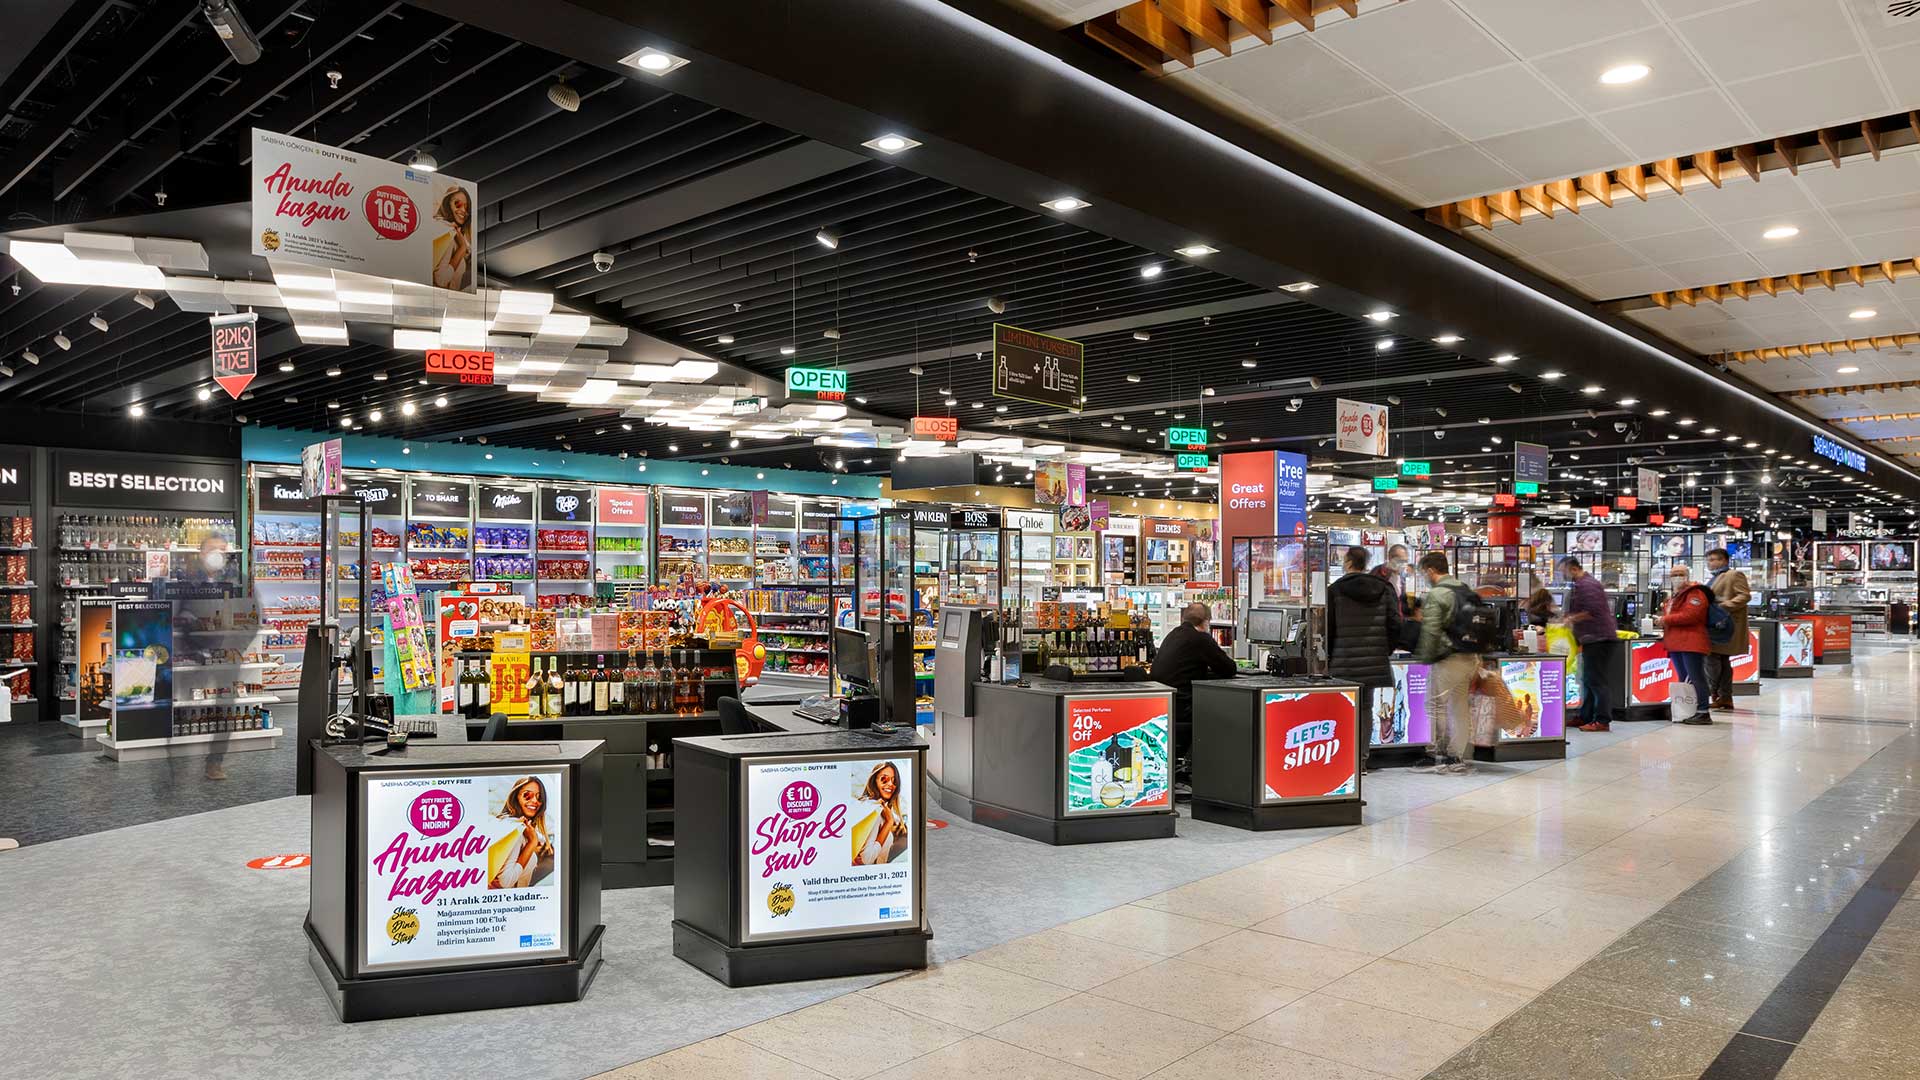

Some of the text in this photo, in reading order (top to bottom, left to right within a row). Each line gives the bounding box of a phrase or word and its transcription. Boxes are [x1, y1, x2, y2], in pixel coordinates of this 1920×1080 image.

[322, 150, 340, 161] DUTY
[340, 154, 358, 164] FREE
[264, 162, 354, 200] Anında
[275, 192, 350, 228] kazan
[374, 198, 410, 223] 10 €
[427, 352, 494, 371] CLOSE
[791, 371, 846, 389] OPEN
[915, 420, 957, 432] CLOSE
[1170, 430, 1206, 444] OPEN
[1179, 455, 1208, 467] OPEN
[1280, 459, 1302, 479] Free
[1403, 464, 1430, 474] OPEN
[69, 472, 224, 494] BEST SELECTION
[1231, 484, 1264, 494] Great
[1280, 479, 1300, 488] Duty Free
[1375, 480, 1398, 489] OPEN
[436, 495, 459, 503] SHARE
[492, 494, 521, 508] Milka
[1230, 498, 1266, 509] Offers
[927, 512, 948, 523] KLEIN
[964, 512, 988, 523] BOSS
[1018, 516, 1044, 528] Chloé
[1576, 510, 1626, 524] Dior
[1640, 668, 1672, 690] yakala
[1073, 716, 1102, 730] 40%
[1073, 730, 1092, 741] Off
[1293, 722, 1330, 745] LET'S
[1283, 739, 1340, 770] shop
[786, 786, 812, 800] € 10
[786, 800, 813, 808] DISCOUNT
[419, 804, 453, 820] 10 €
[752, 804, 847, 855] Shop &
[373, 825, 491, 876] Anında
[762, 846, 818, 878] save
[387, 867, 486, 905] kazan
[802, 878, 821, 886] Valid
[822, 876, 839, 885] thru
[840, 873, 877, 883] December
[878, 872, 890, 880] 31,
[436, 898, 447, 906] 31
[450, 896, 480, 906] Aralık
[482, 894, 512, 904] 2021'e
[437, 908, 492, 919] Mağazamızdan
[437, 918, 474, 927] minimum
[437, 935, 495, 946] indirim kazanın
